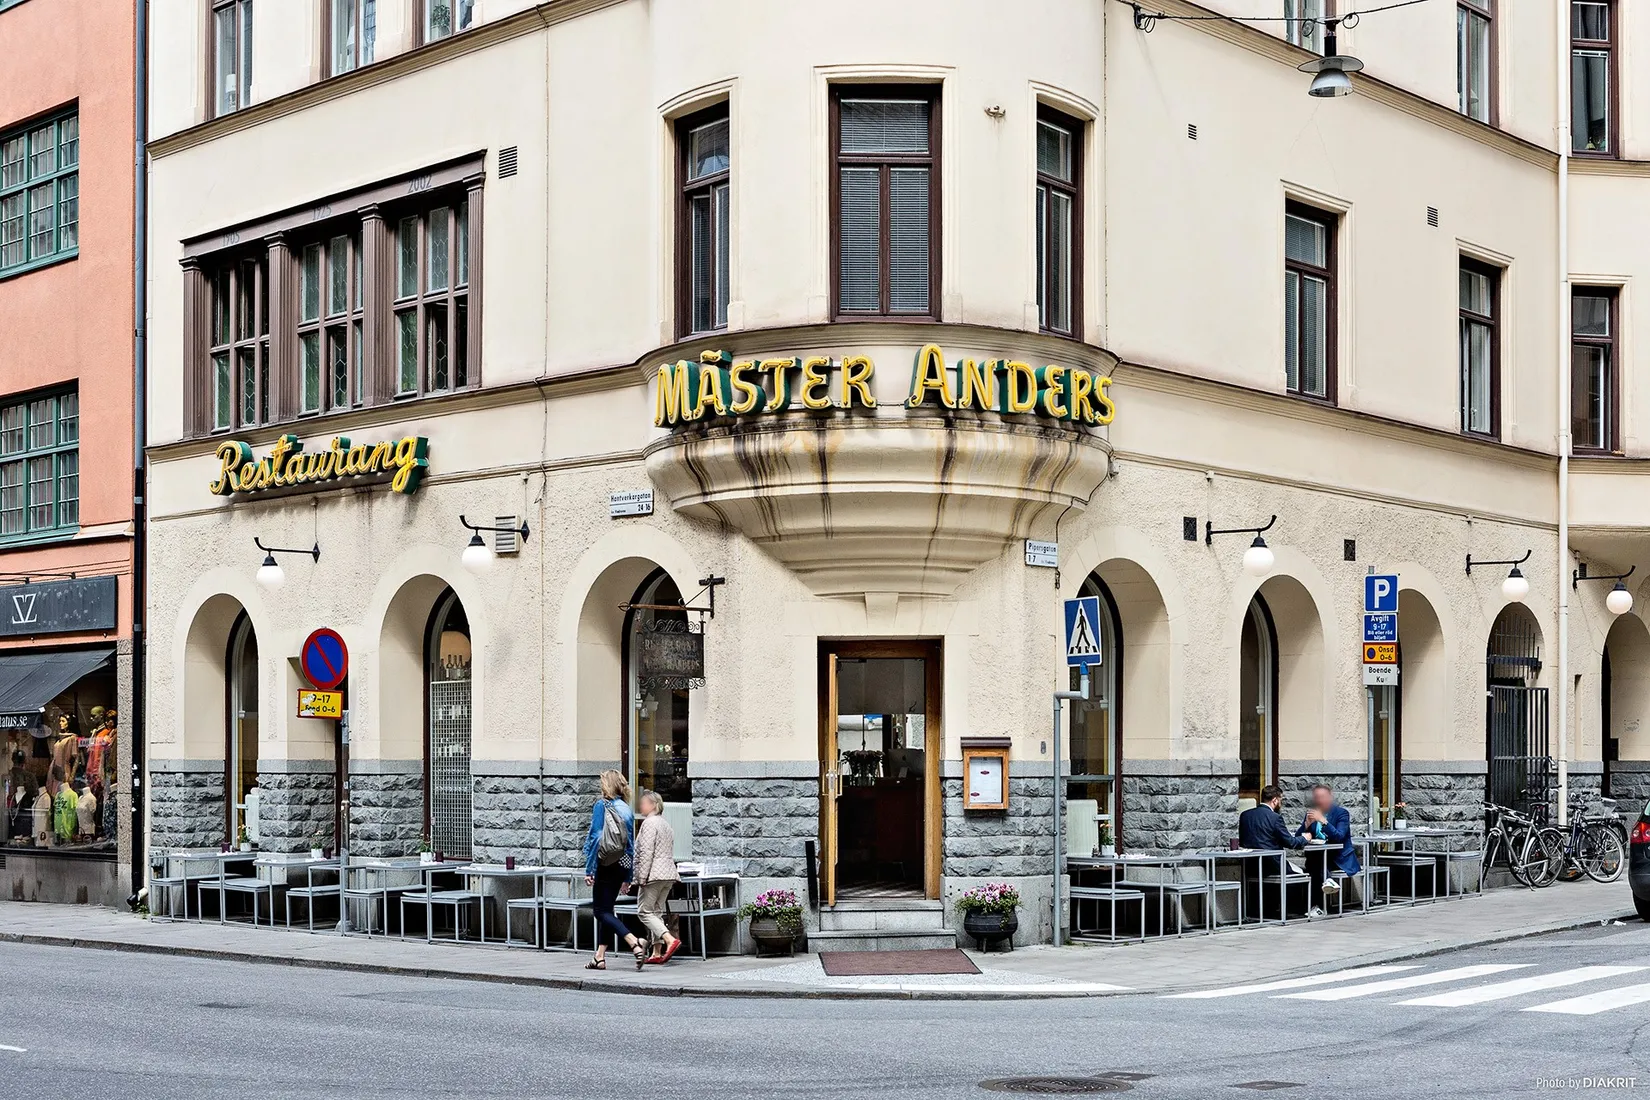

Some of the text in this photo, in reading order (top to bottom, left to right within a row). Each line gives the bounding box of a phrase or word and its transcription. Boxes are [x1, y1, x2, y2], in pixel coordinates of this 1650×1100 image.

[407, 175, 433, 195] 2002
[904, 343, 1116, 426] ANDERS
[209, 433, 429, 496] Restaurang
[1374, 578, 1391, 609] P
[1371, 615, 1389, 623] Avgift
[1368, 666, 1392, 674] Boende
[322, 705, 336, 713] 0-6
